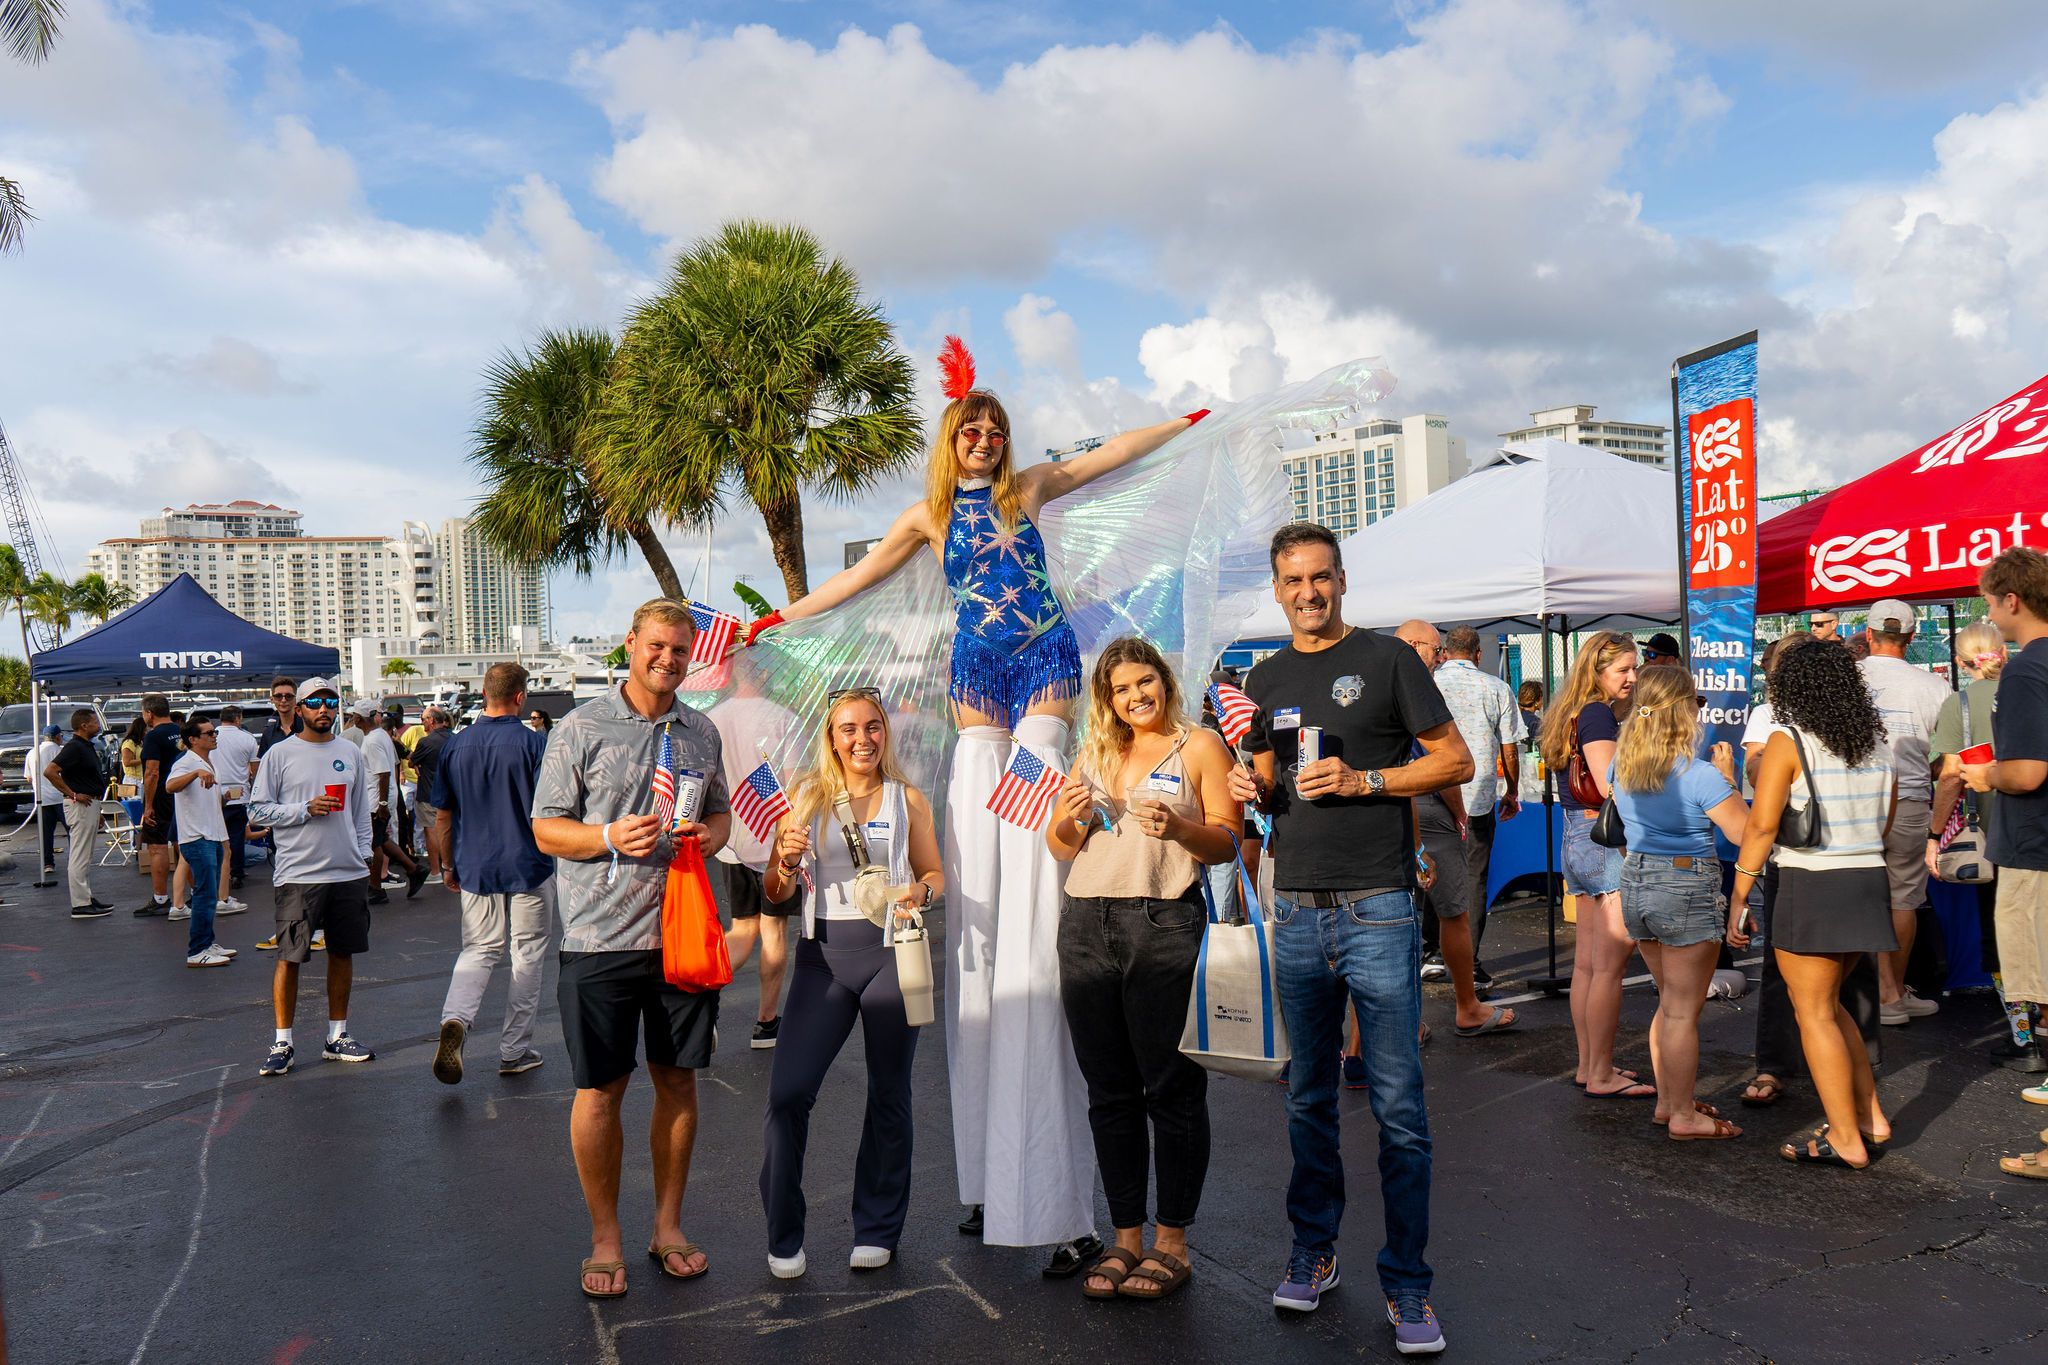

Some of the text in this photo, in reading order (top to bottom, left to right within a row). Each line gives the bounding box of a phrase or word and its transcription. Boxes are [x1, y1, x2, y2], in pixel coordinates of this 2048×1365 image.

[1695, 469, 1745, 517] Lat
[1921, 512, 2031, 573] Lat
[140, 651, 242, 669] TRITON
[1693, 668, 1747, 691] lish
[1697, 703, 1749, 725] tect
[681, 788, 694, 818] Corona
